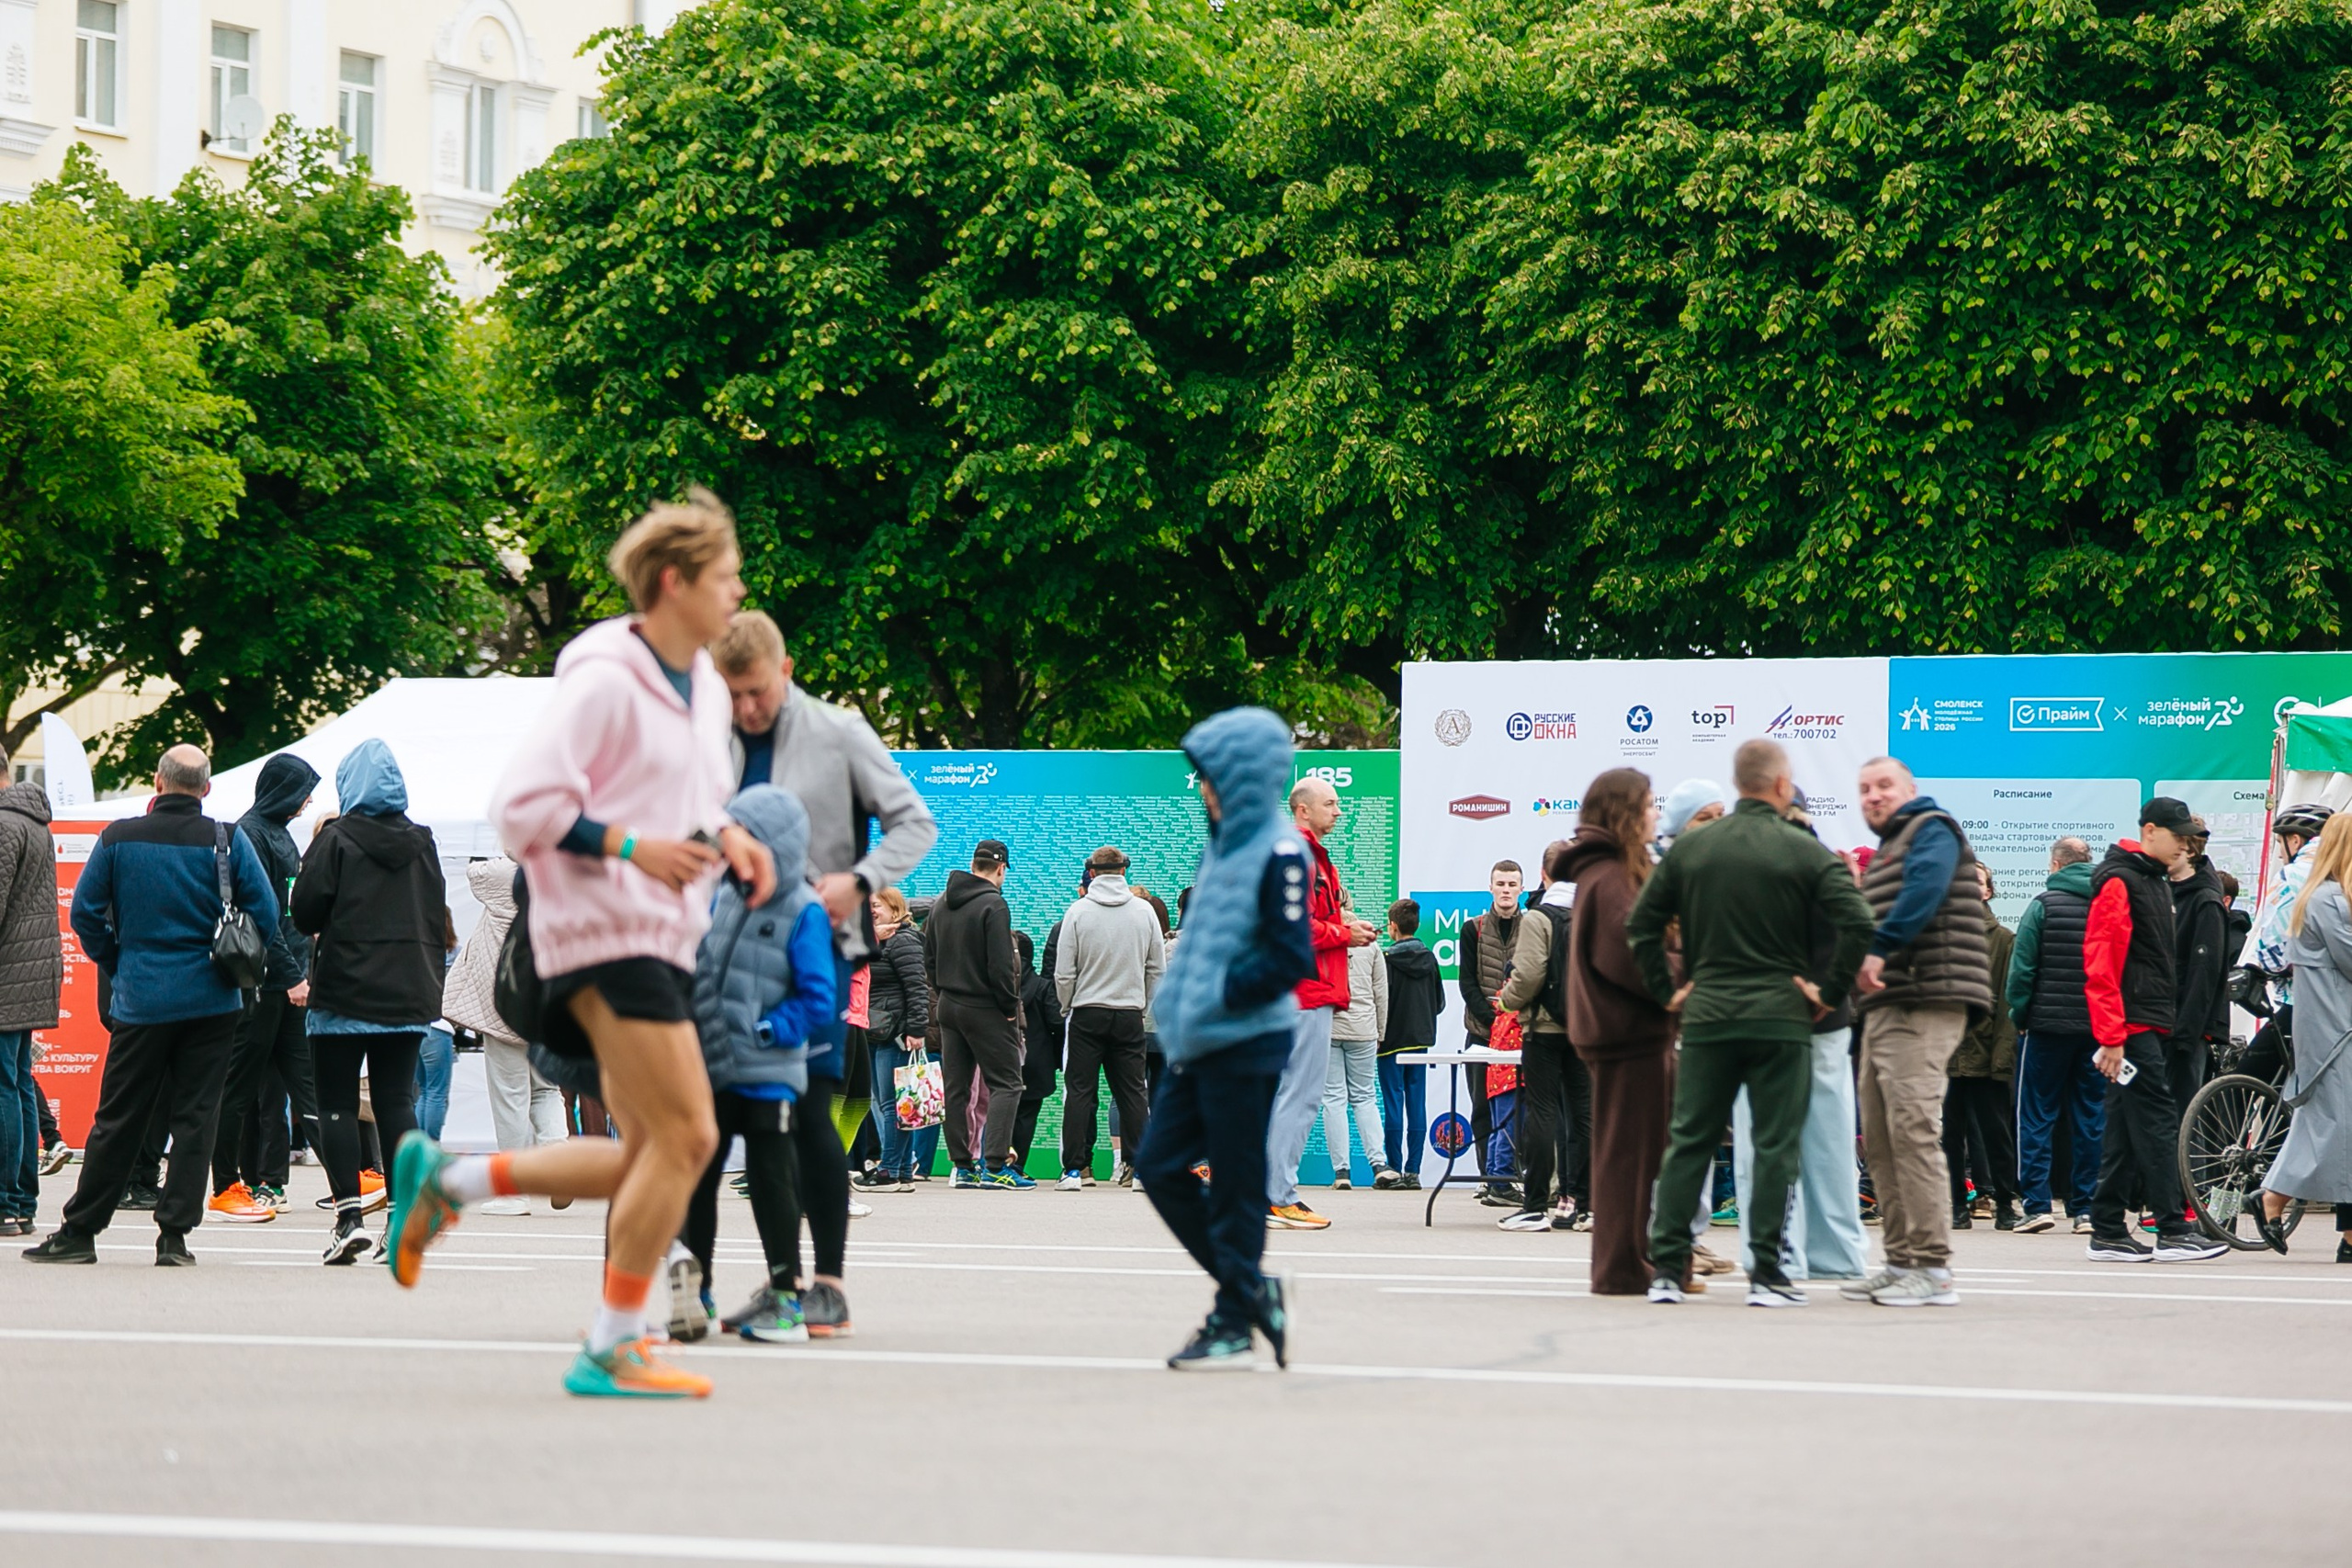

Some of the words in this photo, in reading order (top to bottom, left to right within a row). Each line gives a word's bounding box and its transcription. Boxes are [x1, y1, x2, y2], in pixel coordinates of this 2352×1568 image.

[1934, 700, 1984, 708] СМОЛЕНСК
[2147, 697, 2211, 712] зелёный
[1534, 713, 1577, 724] РУССКИЕ
[1691, 710, 1727, 728] top
[2038, 705, 2090, 723] Прайм
[1794, 715, 1845, 726] ОРТИС
[2138, 713, 2205, 728] марафон
[1534, 724, 1577, 739] ОКНА
[1934, 723, 1957, 731] 2026
[1620, 738, 1659, 746] РОСАТОМ
[931, 762, 975, 773] зелёный
[924, 773, 971, 785] марафон
[1993, 789, 2052, 799] Расписание
[2233, 791, 2265, 800] Схема
[1453, 803, 1508, 813] РОМАНИШИН
[1962, 820, 1989, 829] 09:00
[2001, 820, 2049, 830] Открытие
[2052, 822, 2115, 831] спортивного
[2007, 834, 2057, 842] стартовых
[1972, 844, 2046, 852] звлекательной
[2018, 869, 2051, 877] регист
[51, 1054, 99, 1063] КУЛЬТУРУ
[55, 1065, 93, 1074] ВОКРУГ
